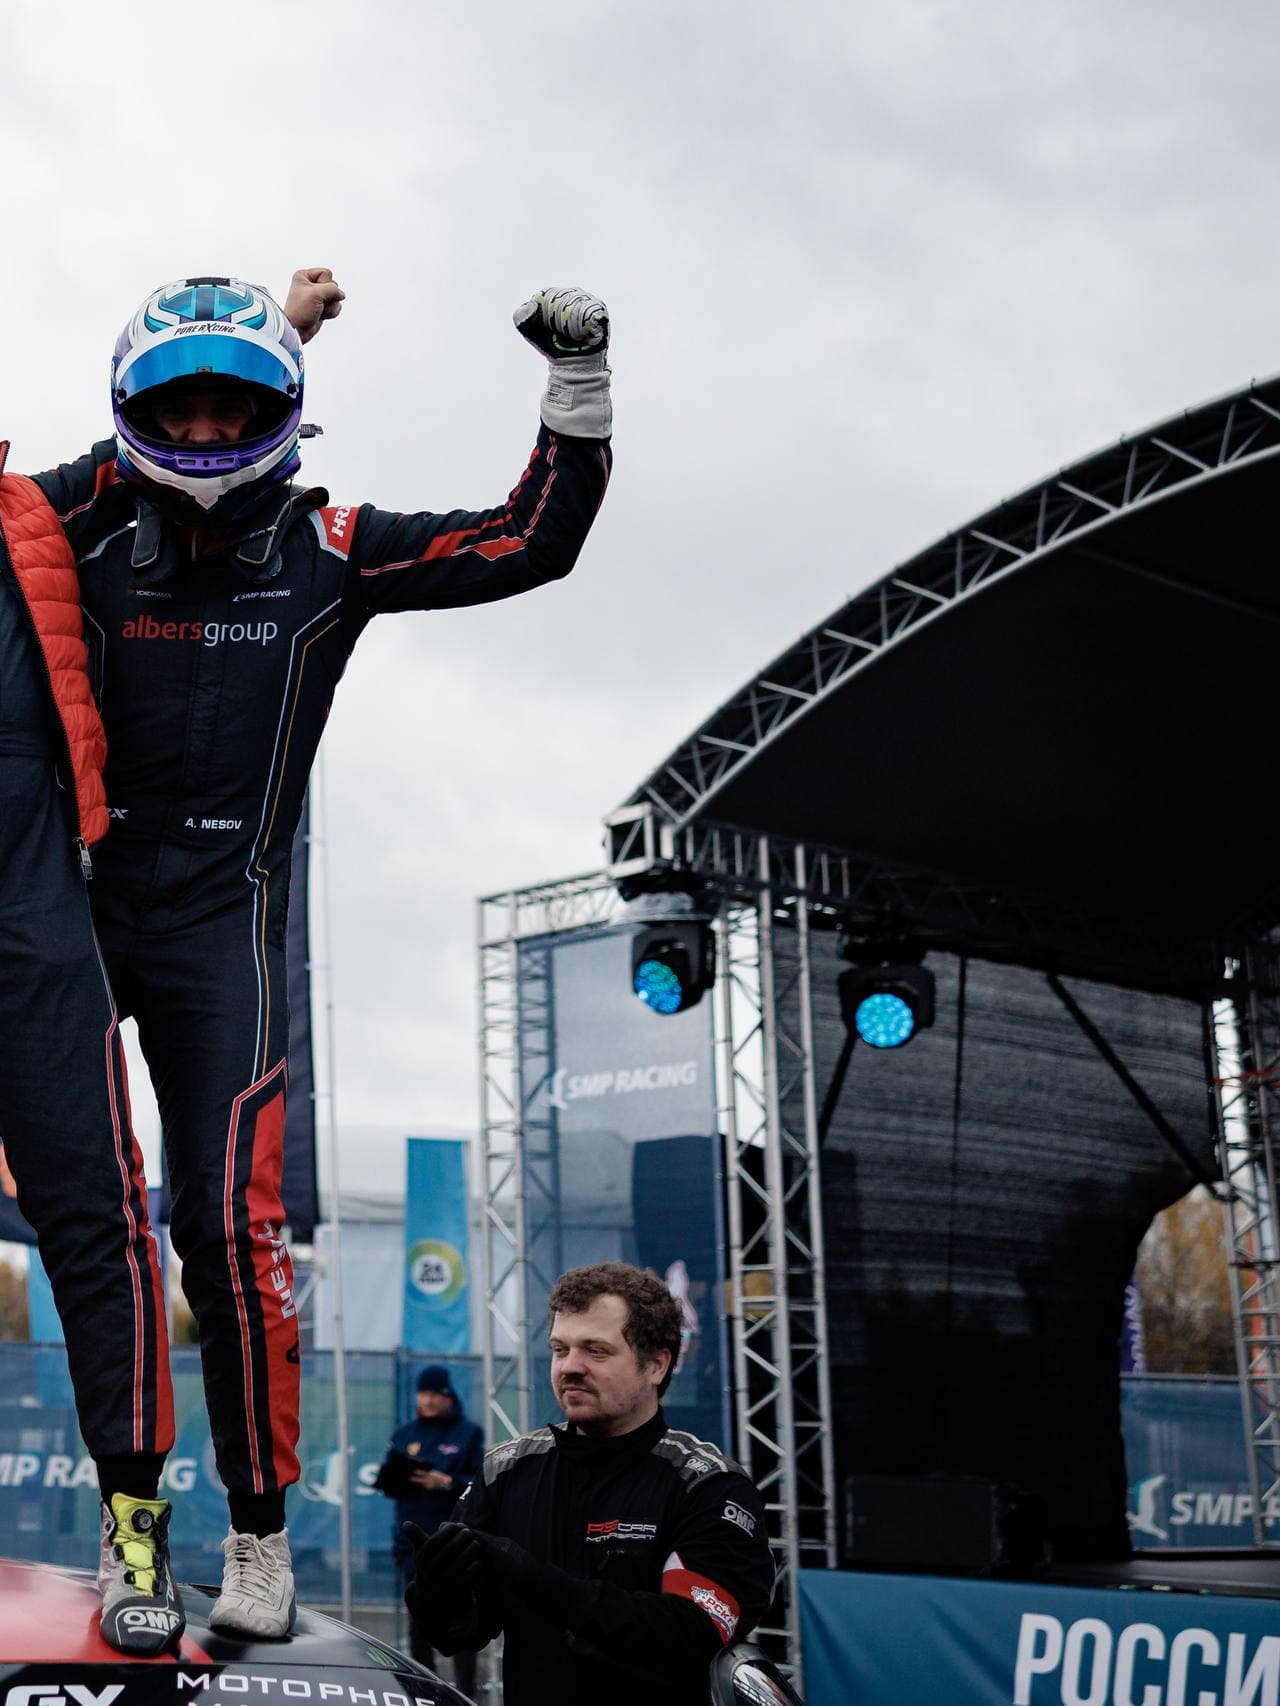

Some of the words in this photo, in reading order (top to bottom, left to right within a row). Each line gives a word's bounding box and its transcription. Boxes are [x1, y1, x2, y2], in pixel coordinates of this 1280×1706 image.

[240, 590, 259, 600] SMP
[260, 589, 291, 599] RACING
[121, 614, 278, 647] albersgroup
[185, 817, 197, 829] A.
[201, 818, 243, 830] NESOV
[568, 1070, 614, 1101] SMP
[615, 1060, 697, 1095] RACING
[43, 1454, 198, 1492] RAG
[723, 1505, 755, 1530] OMP
[1169, 1491, 1255, 1527] SMP
